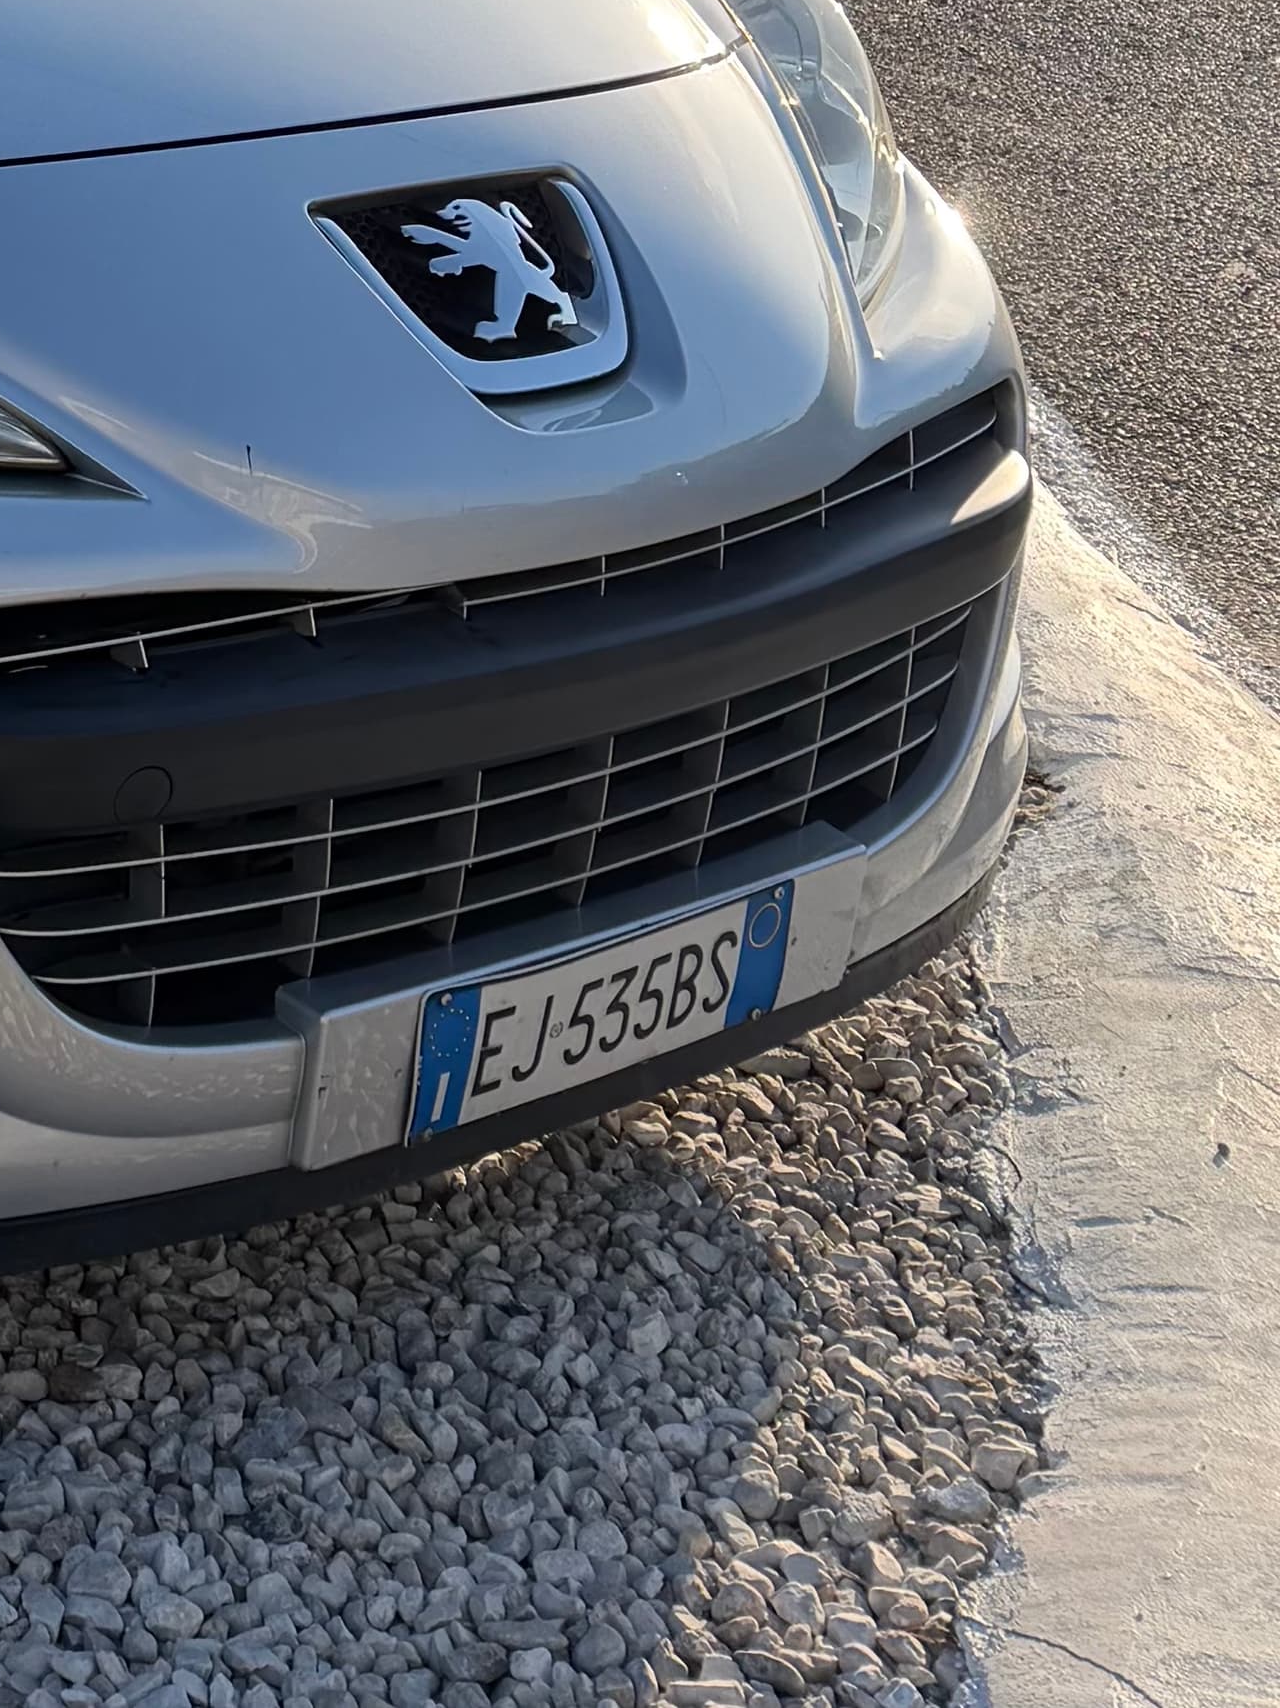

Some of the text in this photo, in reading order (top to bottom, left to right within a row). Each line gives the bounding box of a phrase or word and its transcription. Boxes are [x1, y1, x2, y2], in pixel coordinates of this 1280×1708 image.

[471, 931, 738, 1097] EJ 535BS
[430, 1071, 451, 1123] I
